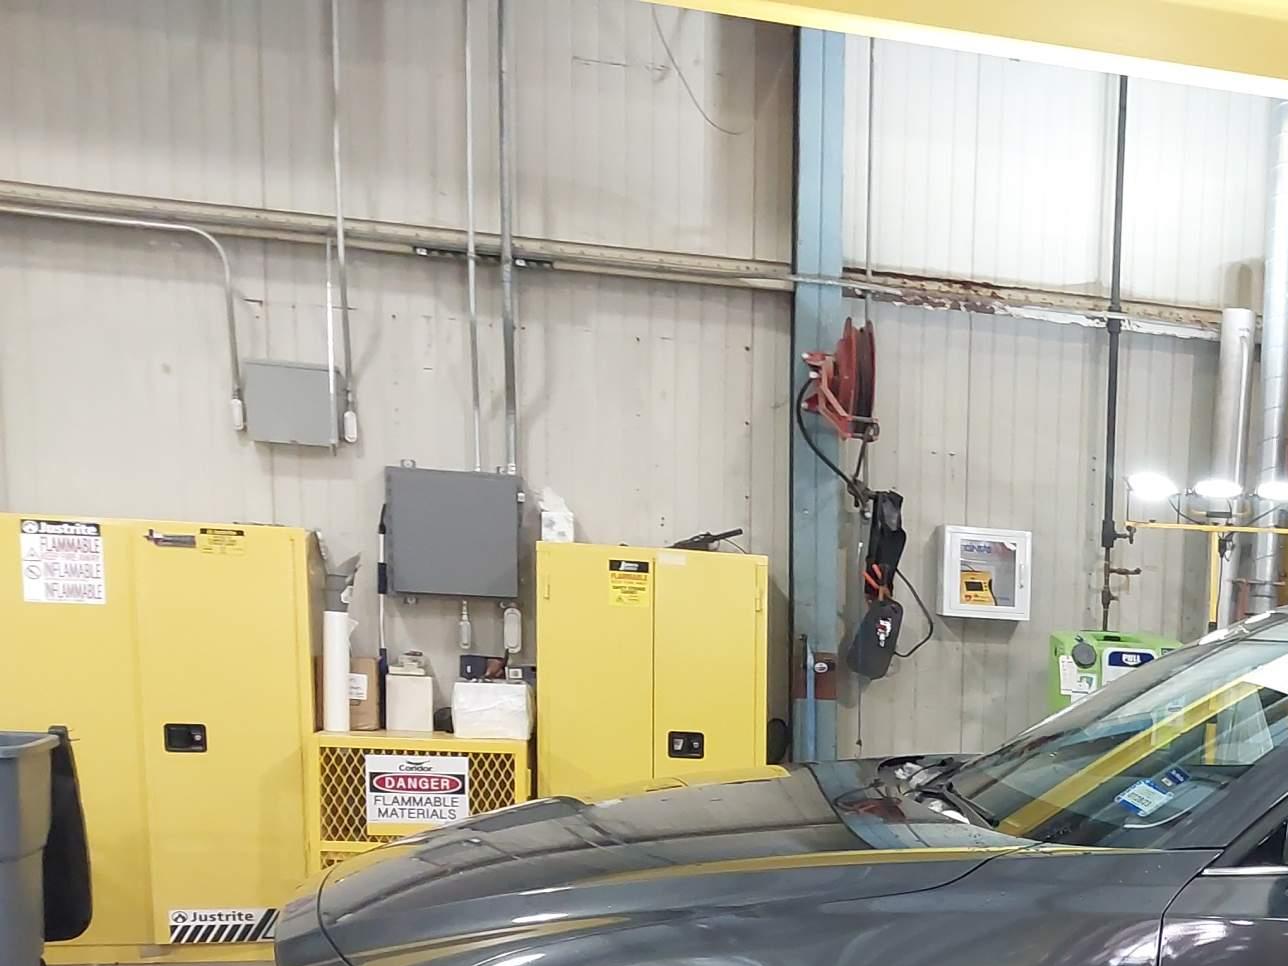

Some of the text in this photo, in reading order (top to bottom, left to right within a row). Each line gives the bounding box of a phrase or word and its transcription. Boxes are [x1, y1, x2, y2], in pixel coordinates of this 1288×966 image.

[39, 521, 98, 536] Justrite
[40, 536, 100, 553] FLAMMABLE
[44, 582, 103, 600] INFLAMMABLE
[398, 764, 432, 772] Condor
[384, 776, 451, 790] DANGER
[374, 795, 460, 808] FLAMMABLE
[377, 807, 457, 820] MATERIALS
[191, 910, 254, 922] Justrite
